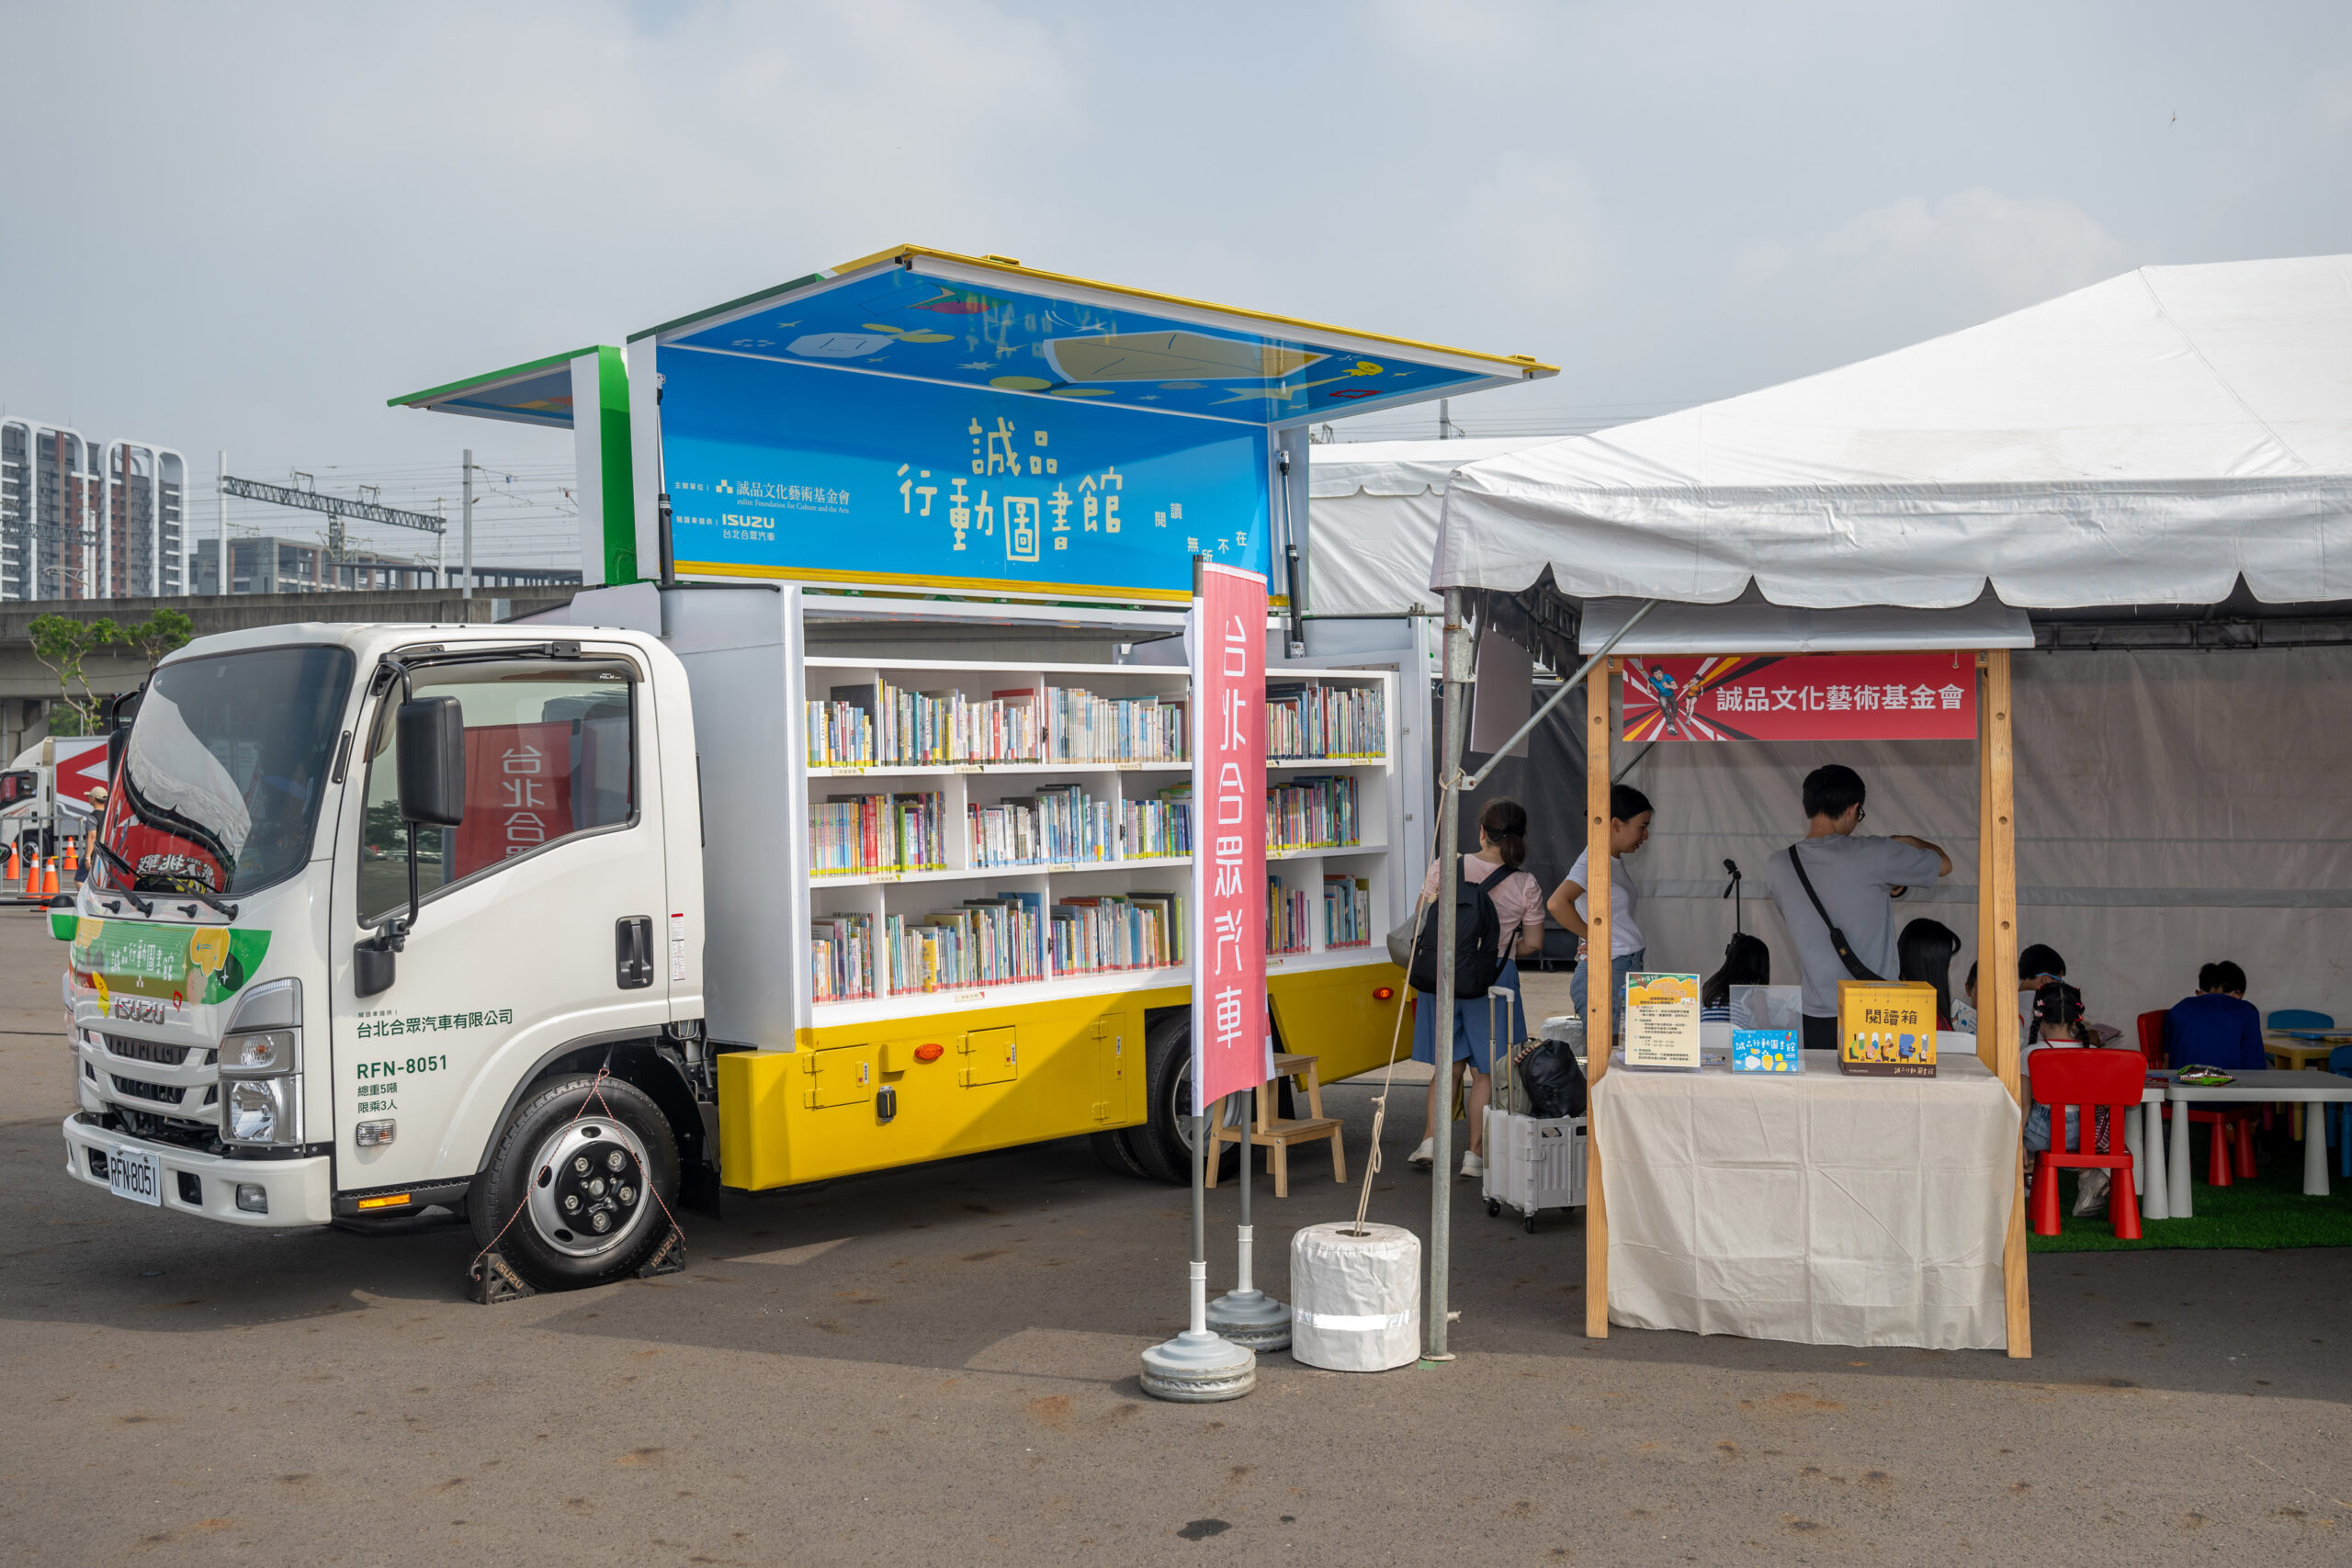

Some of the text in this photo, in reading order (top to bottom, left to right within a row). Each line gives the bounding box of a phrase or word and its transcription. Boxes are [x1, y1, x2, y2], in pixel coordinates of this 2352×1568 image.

[969, 417, 1057, 477] 誠品
[736, 480, 851, 505] 誠品文化藝術基金會
[755, 499, 786, 509] Foundation
[787, 502, 796, 510] for
[797, 502, 817, 511] Culture
[722, 513, 775, 529] ISUZU
[897, 463, 1123, 562] 行動圖書館
[723, 529, 775, 542] 台北合眾汽車
[1715, 683, 1966, 712] 誠品文化藝術基金會
[114, 996, 165, 1025] ISUZU
[356, 1009, 513, 1039] 台北合眾汽車有限公司
[1865, 1009, 1917, 1026] 閱讀箱
[356, 1055, 447, 1079] RFN-8051
[357, 1082, 398, 1097] 總重5噸
[357, 1099, 398, 1113] 限乘3人
[110, 1156, 157, 1197] RFN-8051
[650, 1234, 678, 1268] ISUZU
[494, 1260, 524, 1290] ISUZU
